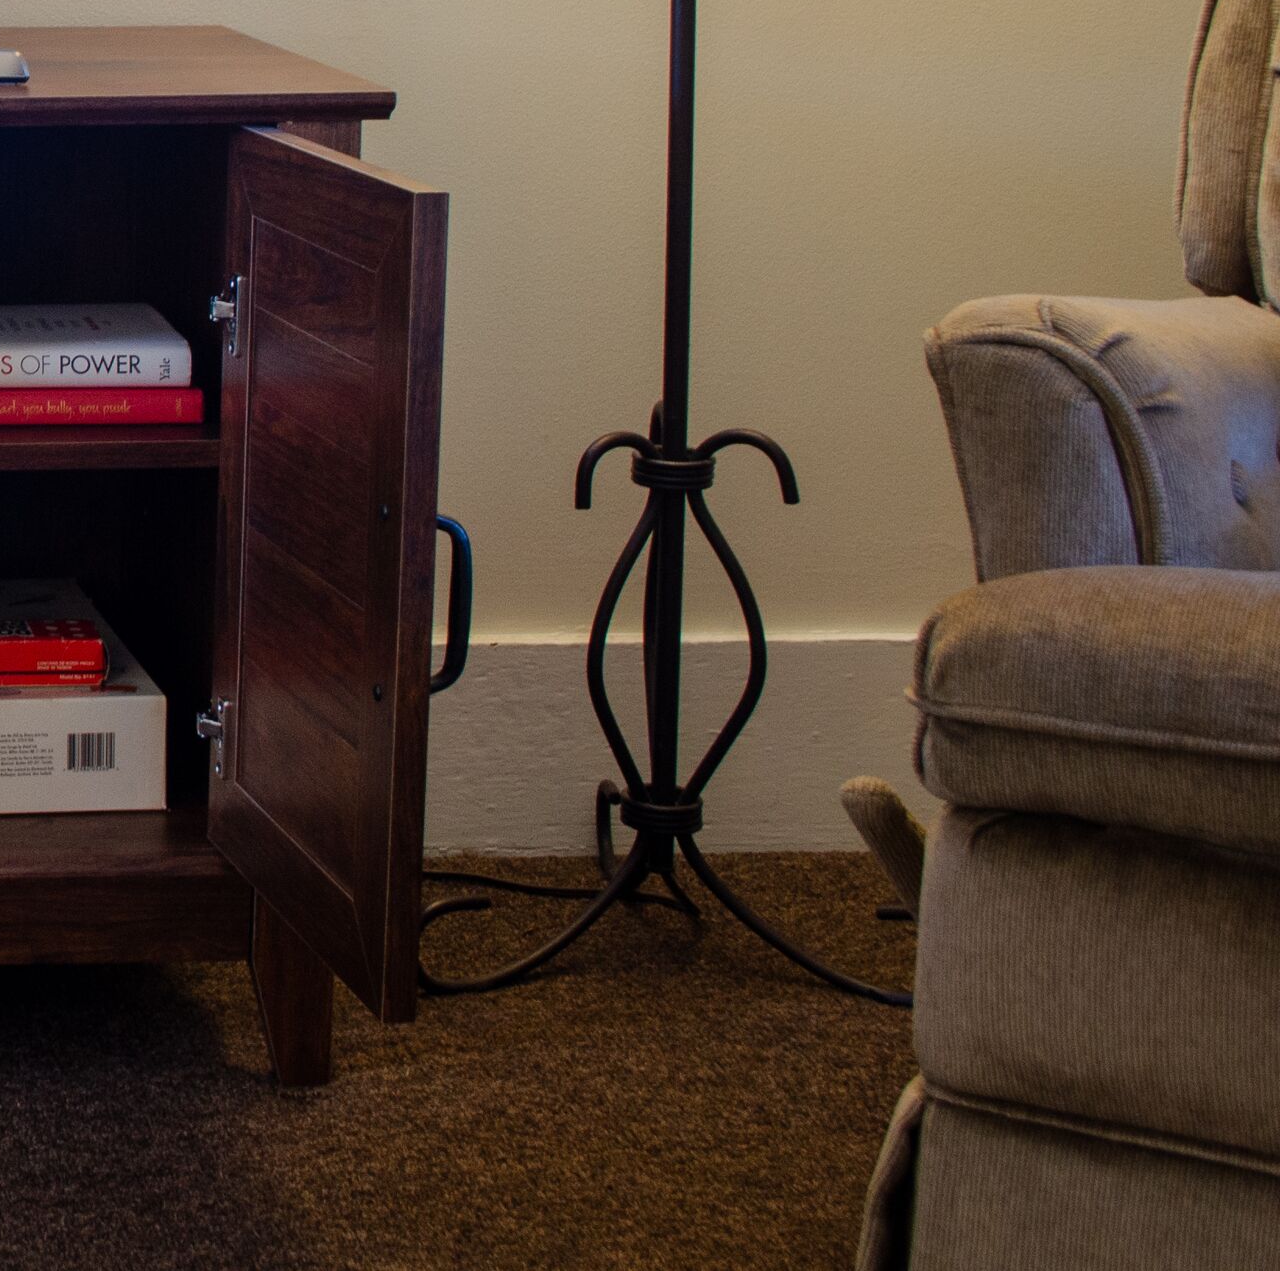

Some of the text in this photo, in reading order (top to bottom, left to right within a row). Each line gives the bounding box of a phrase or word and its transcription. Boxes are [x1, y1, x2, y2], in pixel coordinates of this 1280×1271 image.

[20, 355, 51, 375] OF
[59, 354, 142, 375] POWER
[159, 357, 171, 381] Yale
[23, 403, 42, 420] you
[78, 403, 99, 419] you
[102, 400, 132, 418] punk
